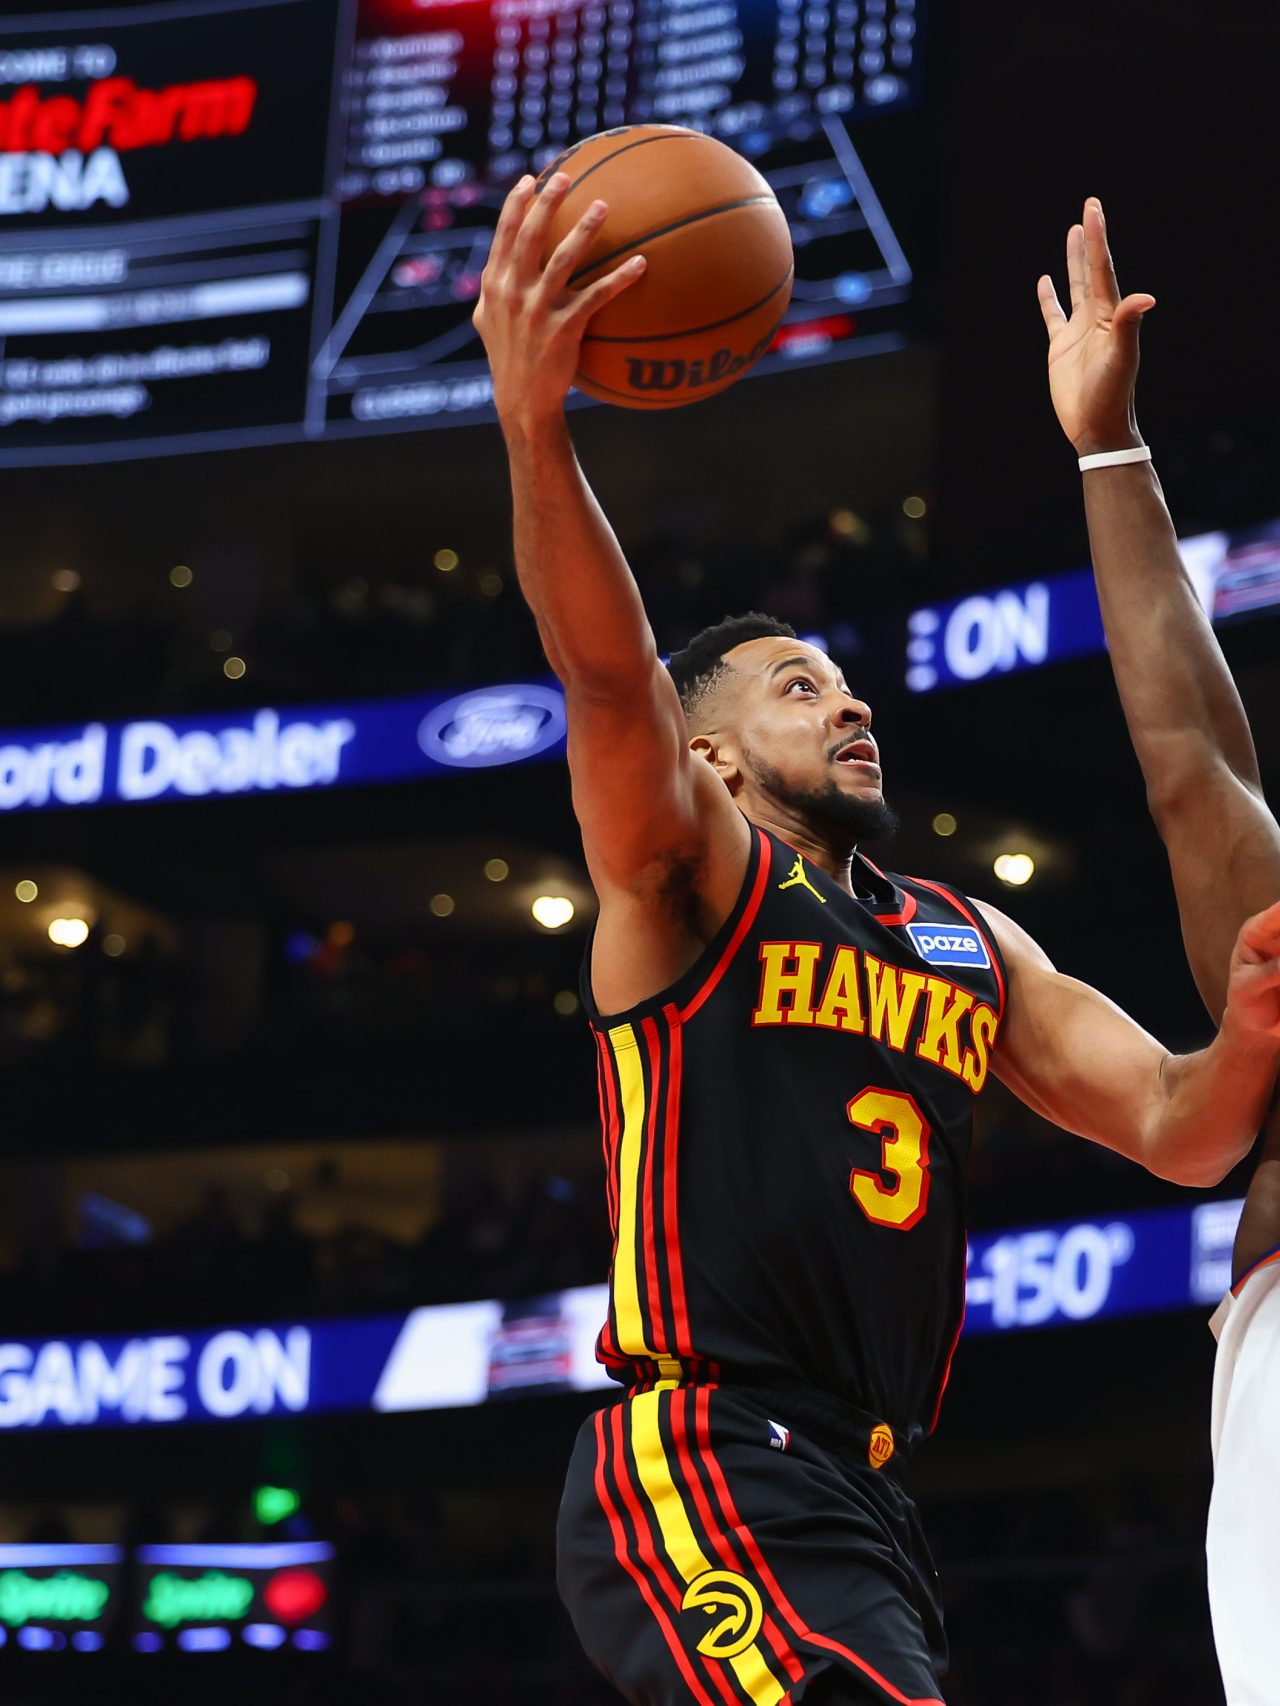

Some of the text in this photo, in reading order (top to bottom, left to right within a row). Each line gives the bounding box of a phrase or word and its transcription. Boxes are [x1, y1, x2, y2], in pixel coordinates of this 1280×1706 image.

[944, 582, 1050, 681] ON
[117, 708, 355, 801] Dealer
[917, 935, 979, 954] paze
[751, 941, 998, 1095] HAWKS
[846, 1085, 931, 1232] 3
[0, 1326, 312, 1426] GAME ON
[873, 1435, 890, 1458] ATL
